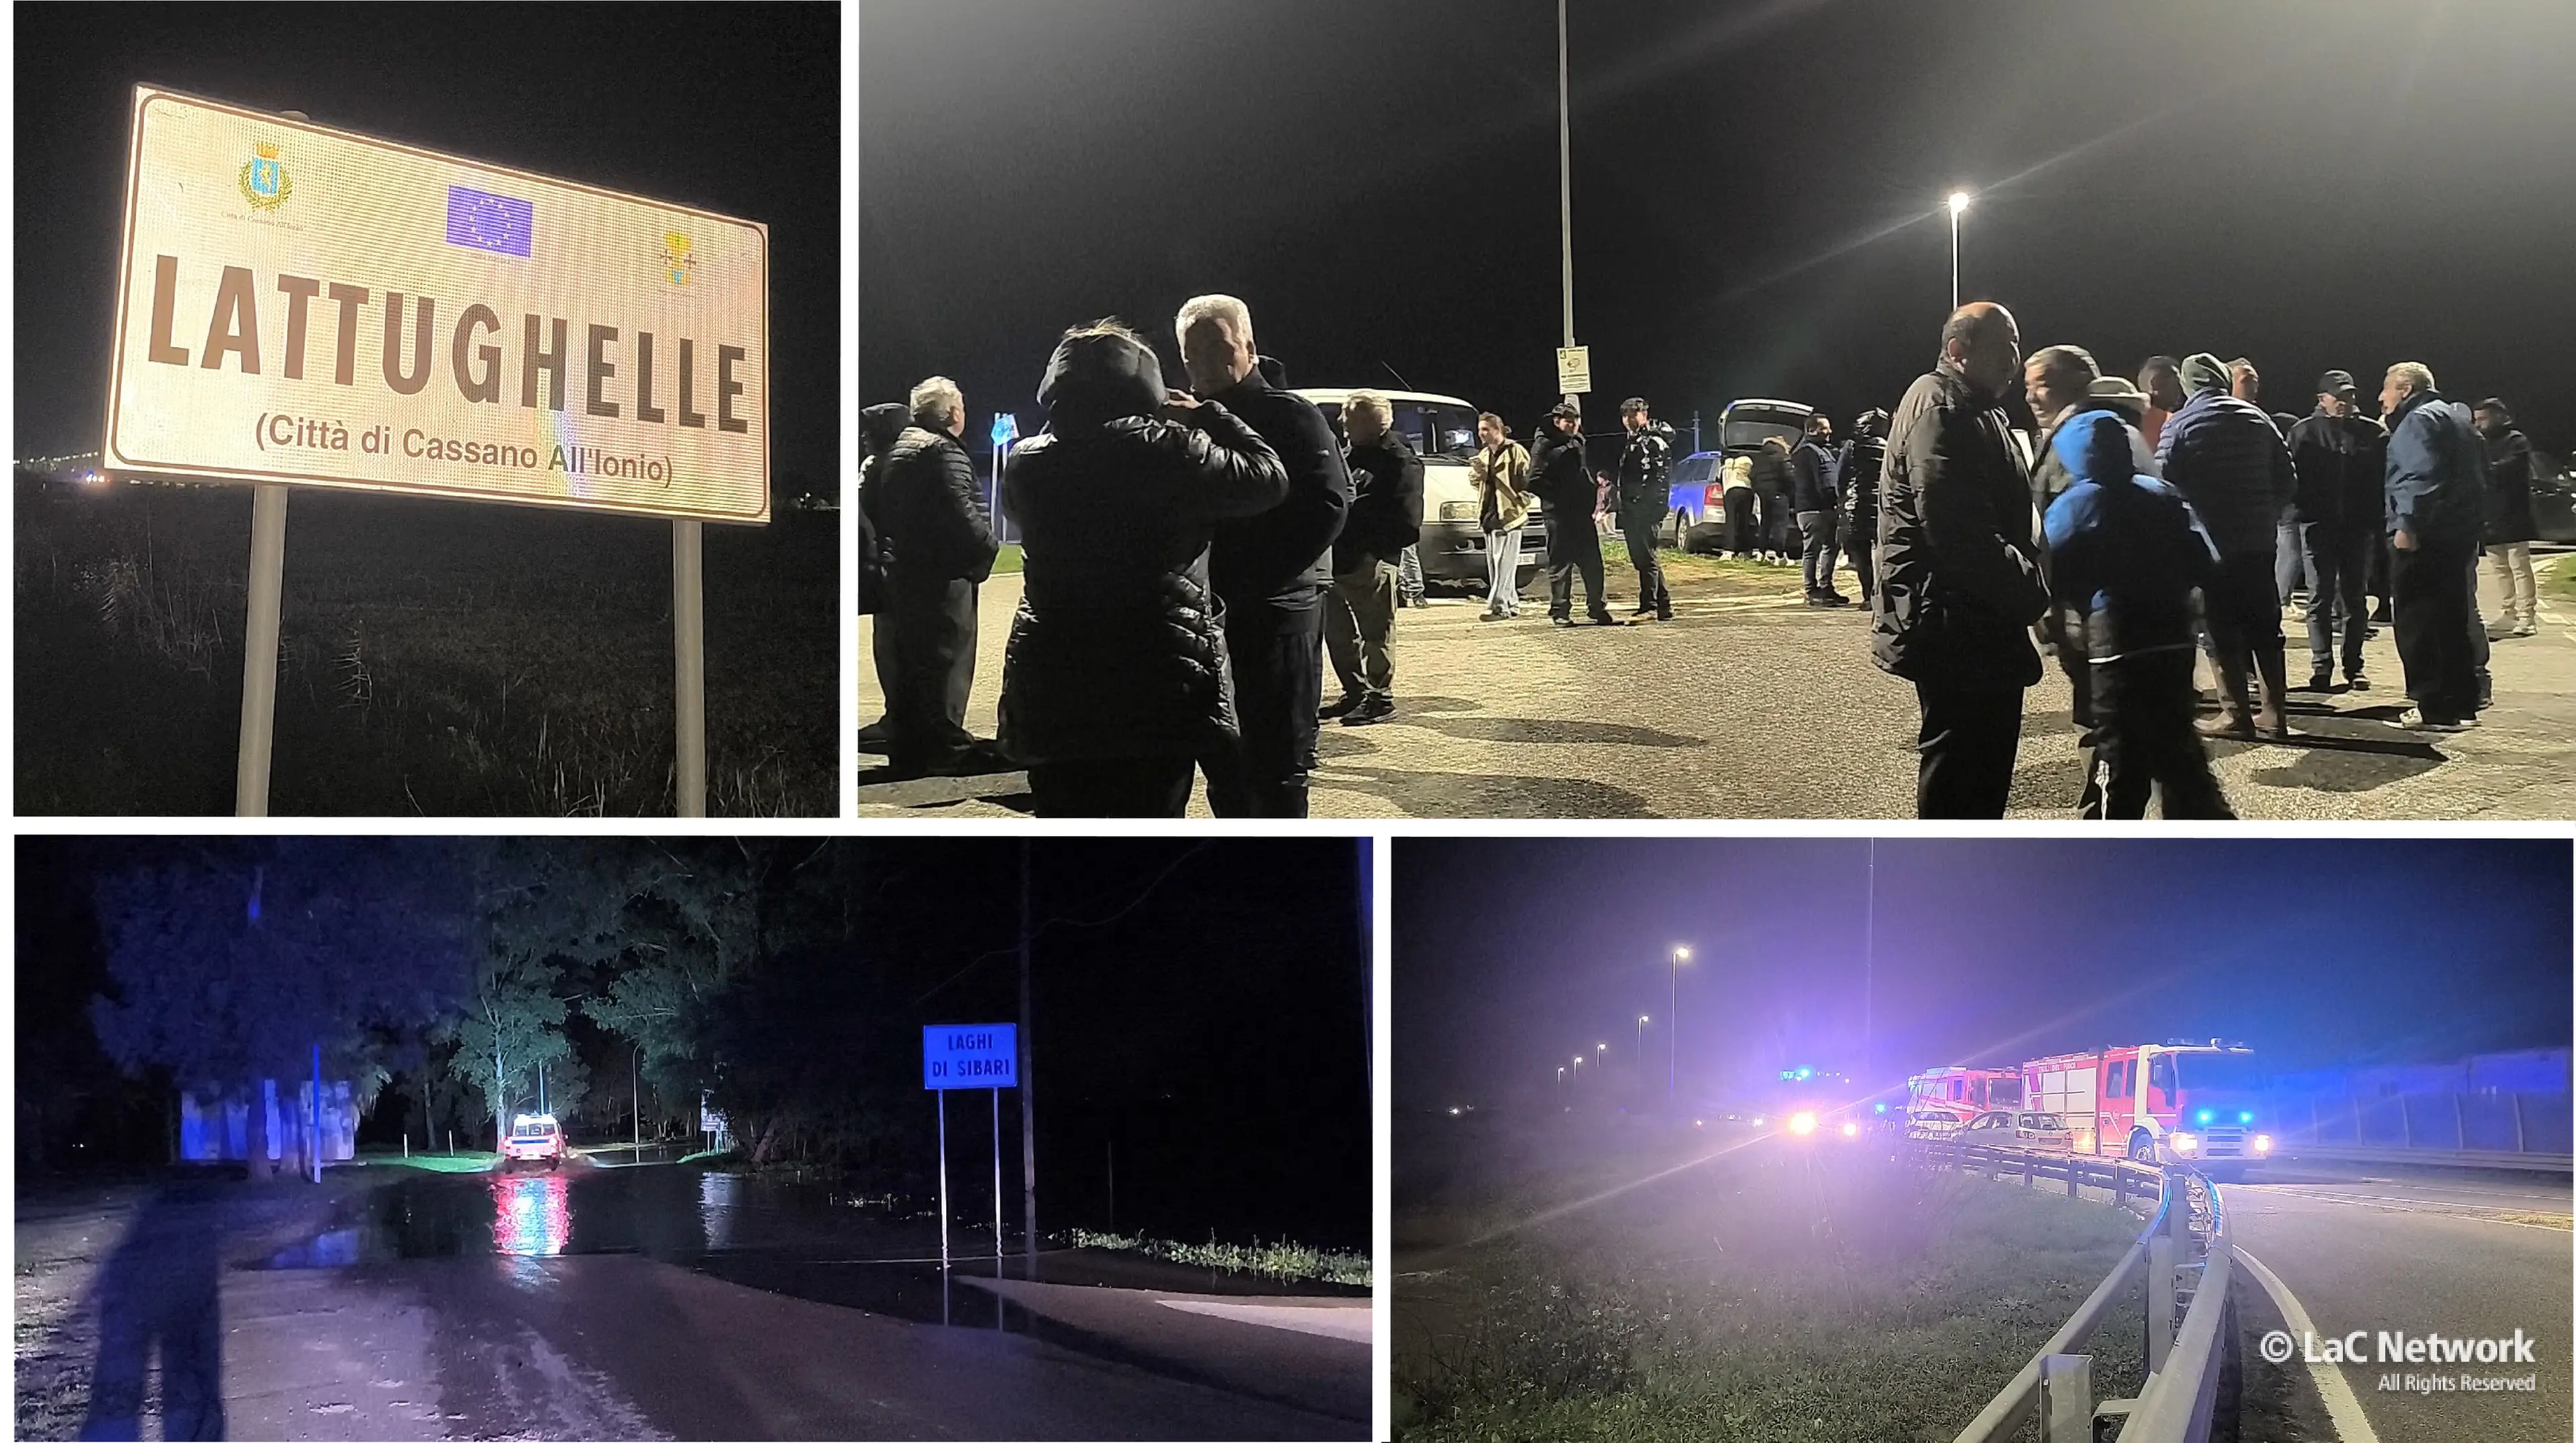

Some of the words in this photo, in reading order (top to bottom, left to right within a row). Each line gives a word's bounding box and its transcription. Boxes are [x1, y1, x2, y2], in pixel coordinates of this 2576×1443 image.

[148, 254, 749, 434] LATTUGHELLE
[256, 413, 349, 451] (Città
[361, 425, 390, 454] di
[403, 428, 537, 468] Cassano
[548, 444, 672, 488] All'Ionio)
[948, 1034, 992, 1051] LAGHI
[932, 1061, 947, 1077] DI
[957, 1059, 1010, 1077] SIBARI
